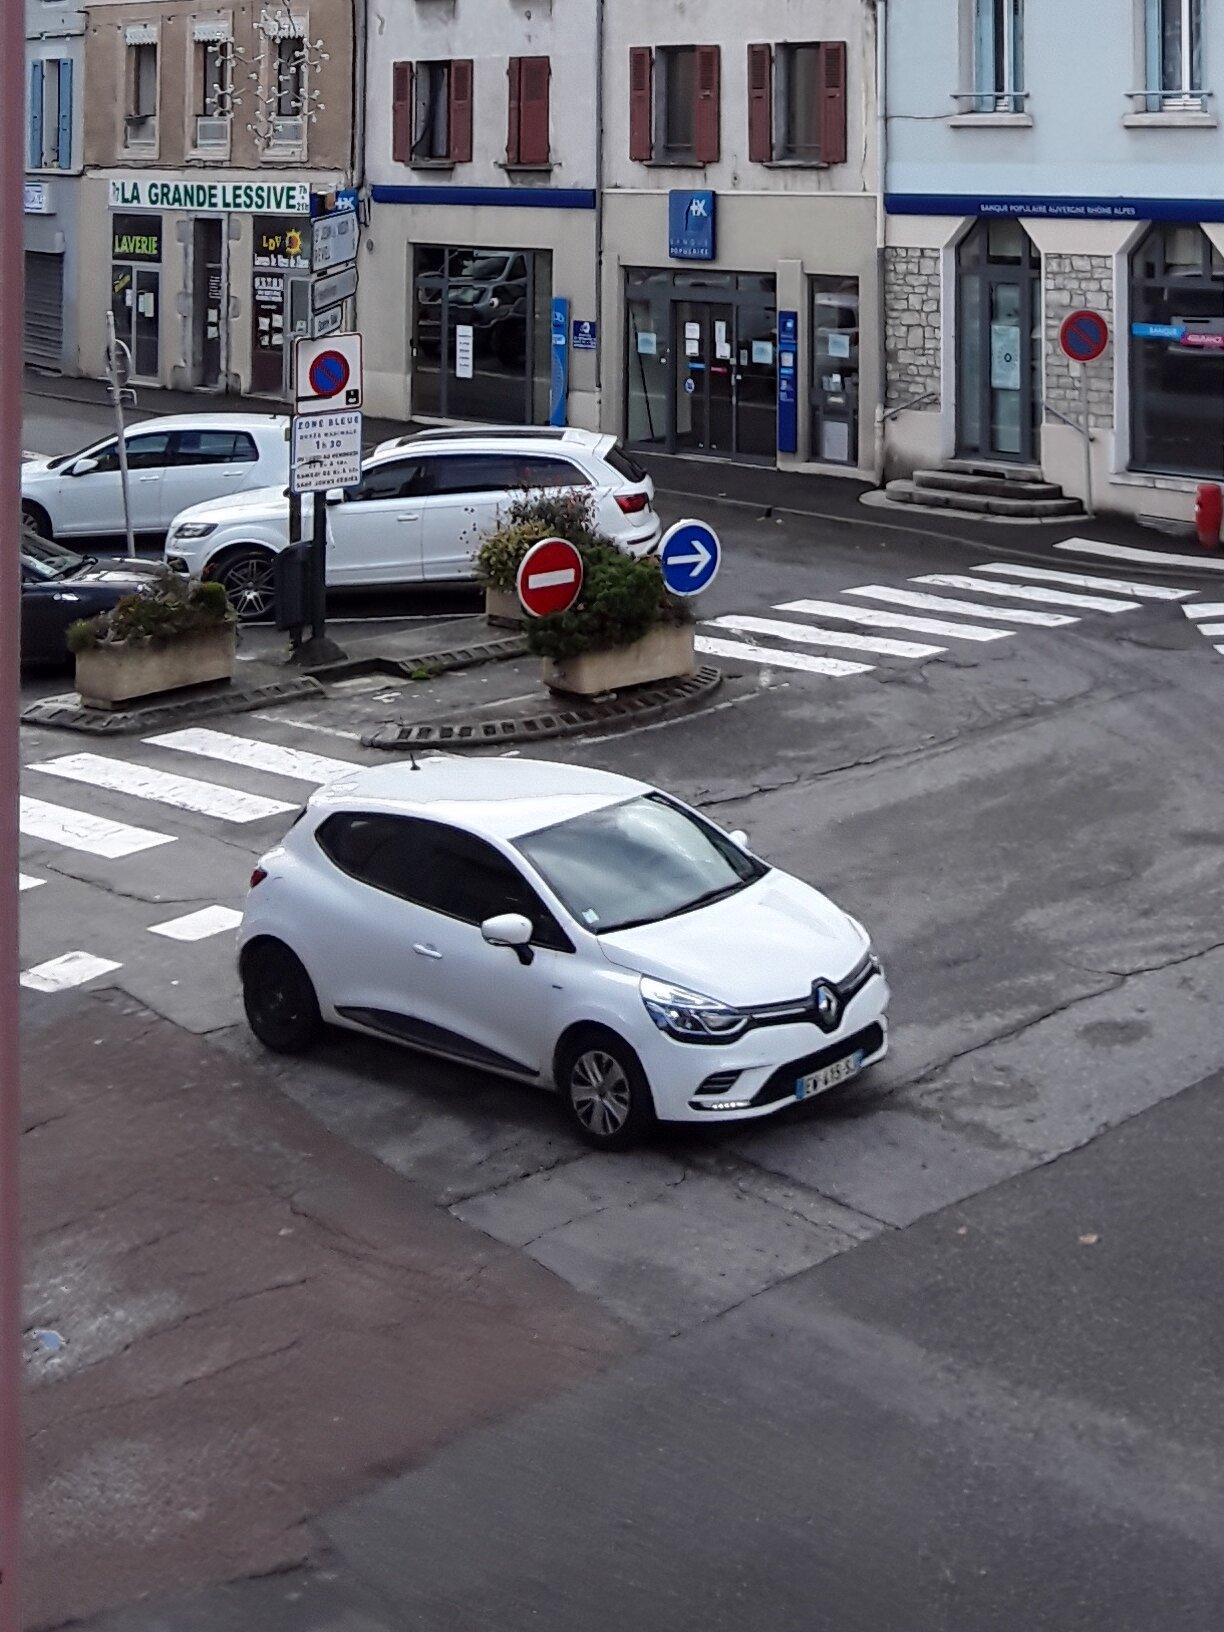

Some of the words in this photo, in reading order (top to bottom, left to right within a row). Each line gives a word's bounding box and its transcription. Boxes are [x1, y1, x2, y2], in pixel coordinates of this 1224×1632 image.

[121, 182, 141, 204] LA
[148, 183, 218, 208] GRANDE
[222, 185, 297, 210] LESSIVE
[114, 235, 158, 254] LAVERIE
